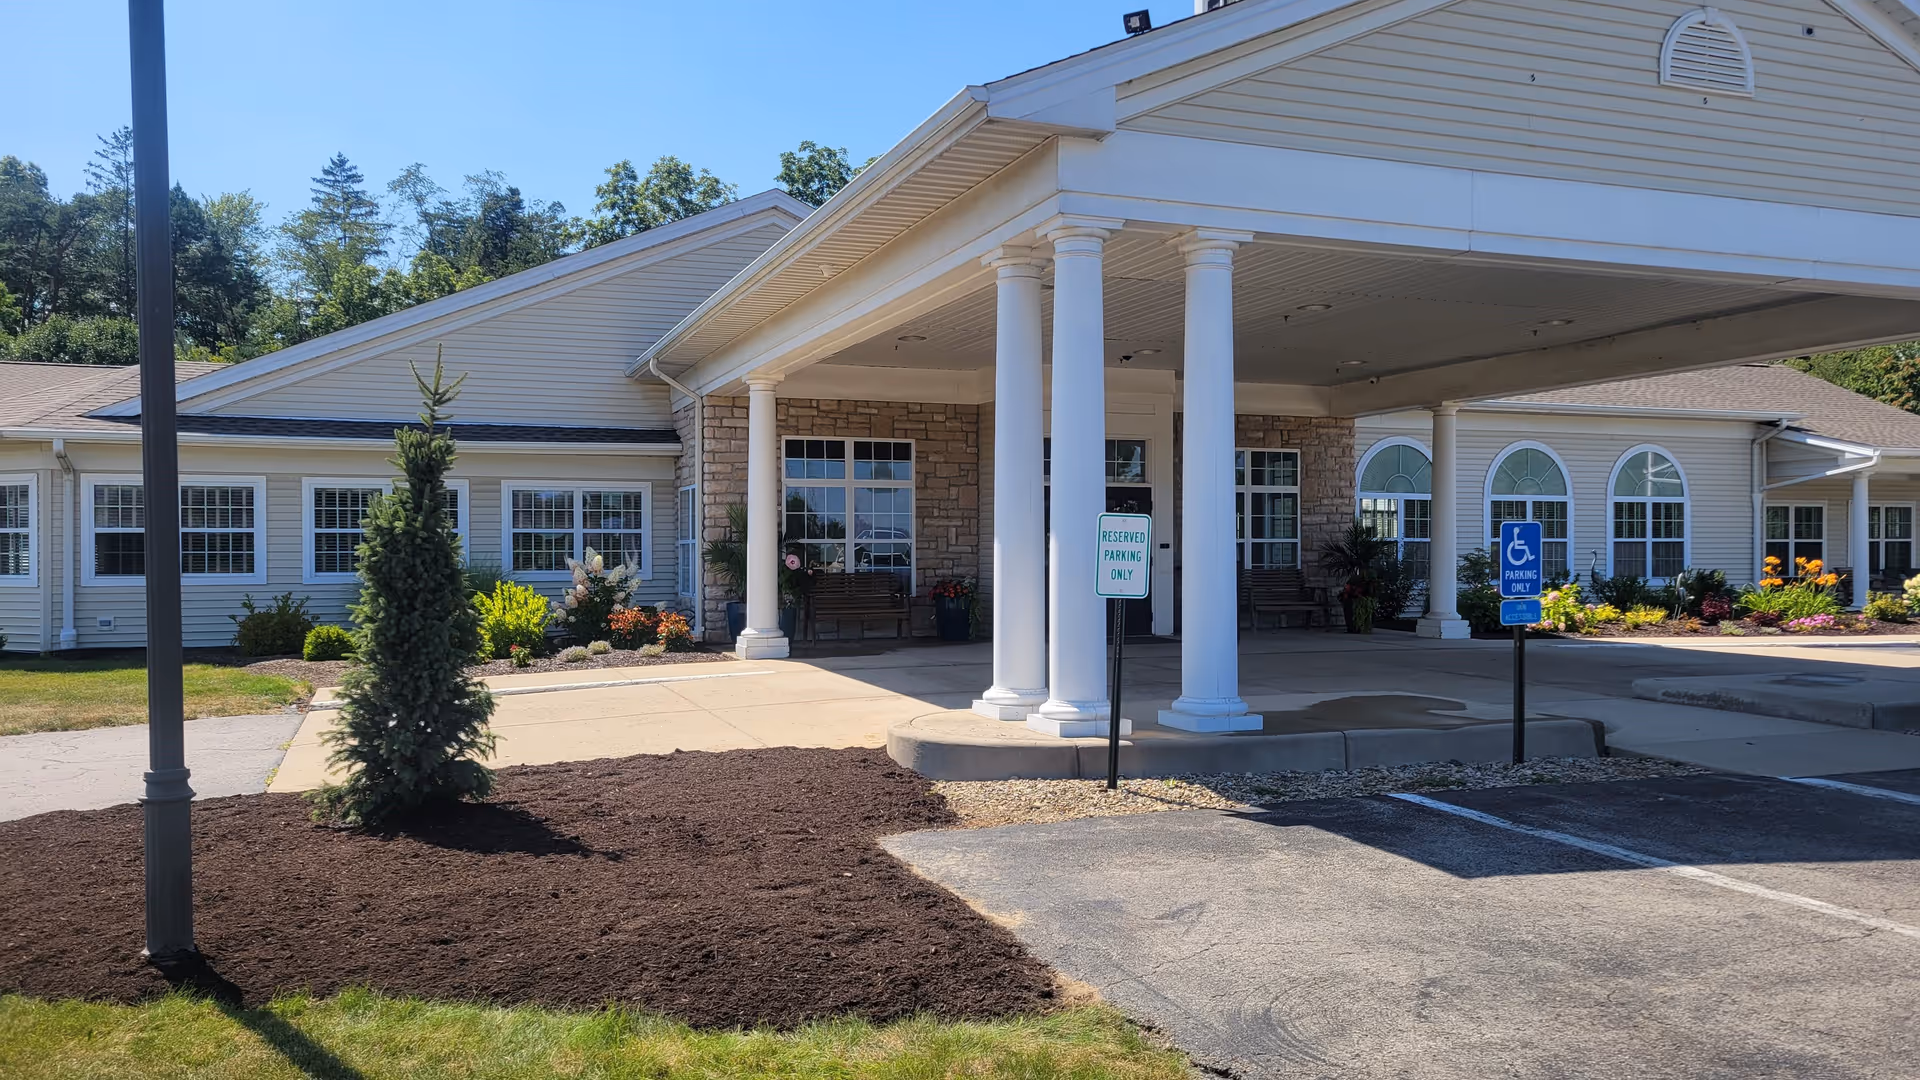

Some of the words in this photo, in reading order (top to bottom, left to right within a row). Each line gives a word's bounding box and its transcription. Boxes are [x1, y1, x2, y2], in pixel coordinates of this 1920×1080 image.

[1102, 531, 1145, 543] RESERVED
[1104, 550, 1142, 562] PARKING
[1111, 569, 1133, 580] ONLY
[1505, 570, 1537, 580] PARKING
[1511, 583, 1530, 593] ONLY
